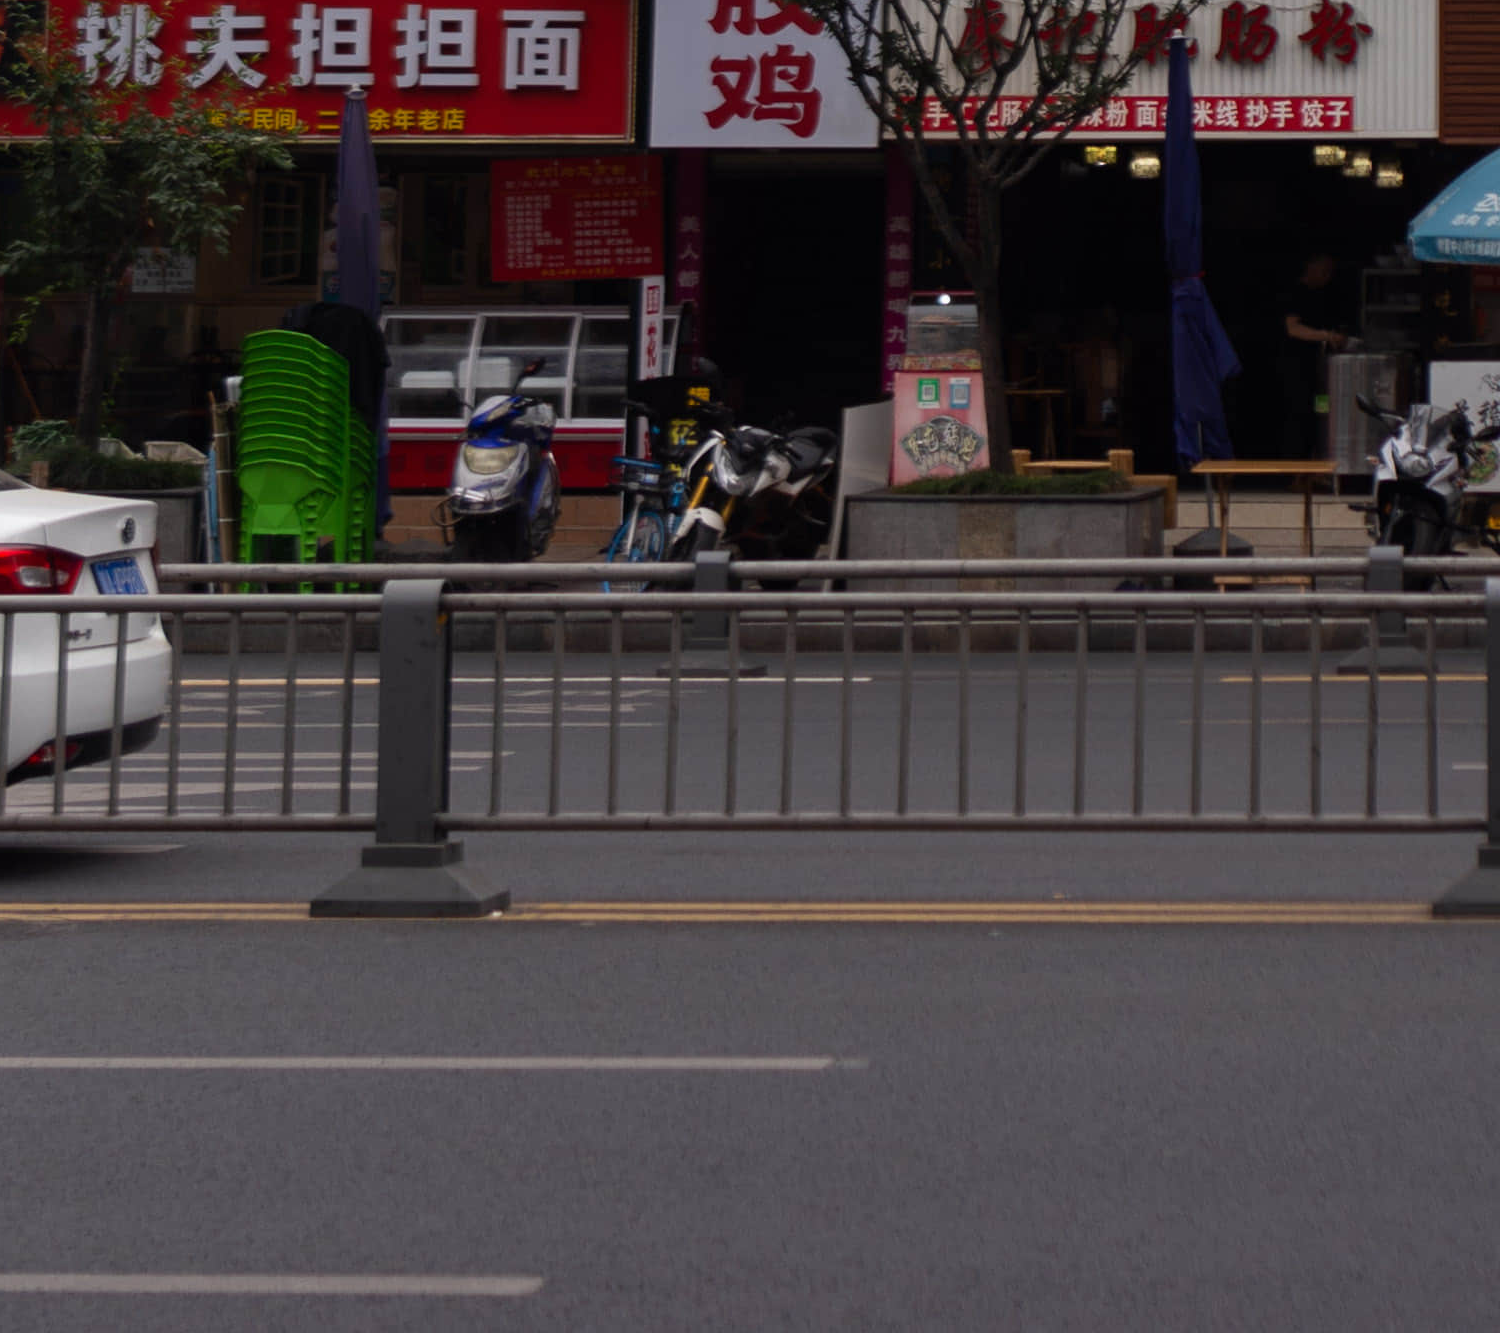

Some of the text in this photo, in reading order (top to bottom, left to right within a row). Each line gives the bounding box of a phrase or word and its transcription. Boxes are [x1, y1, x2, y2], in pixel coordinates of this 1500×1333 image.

[75, 1, 587, 91] 挑夫担担面
[1245, 99, 1293, 128] 抄手
[1301, 99, 1350, 128] 饺子
